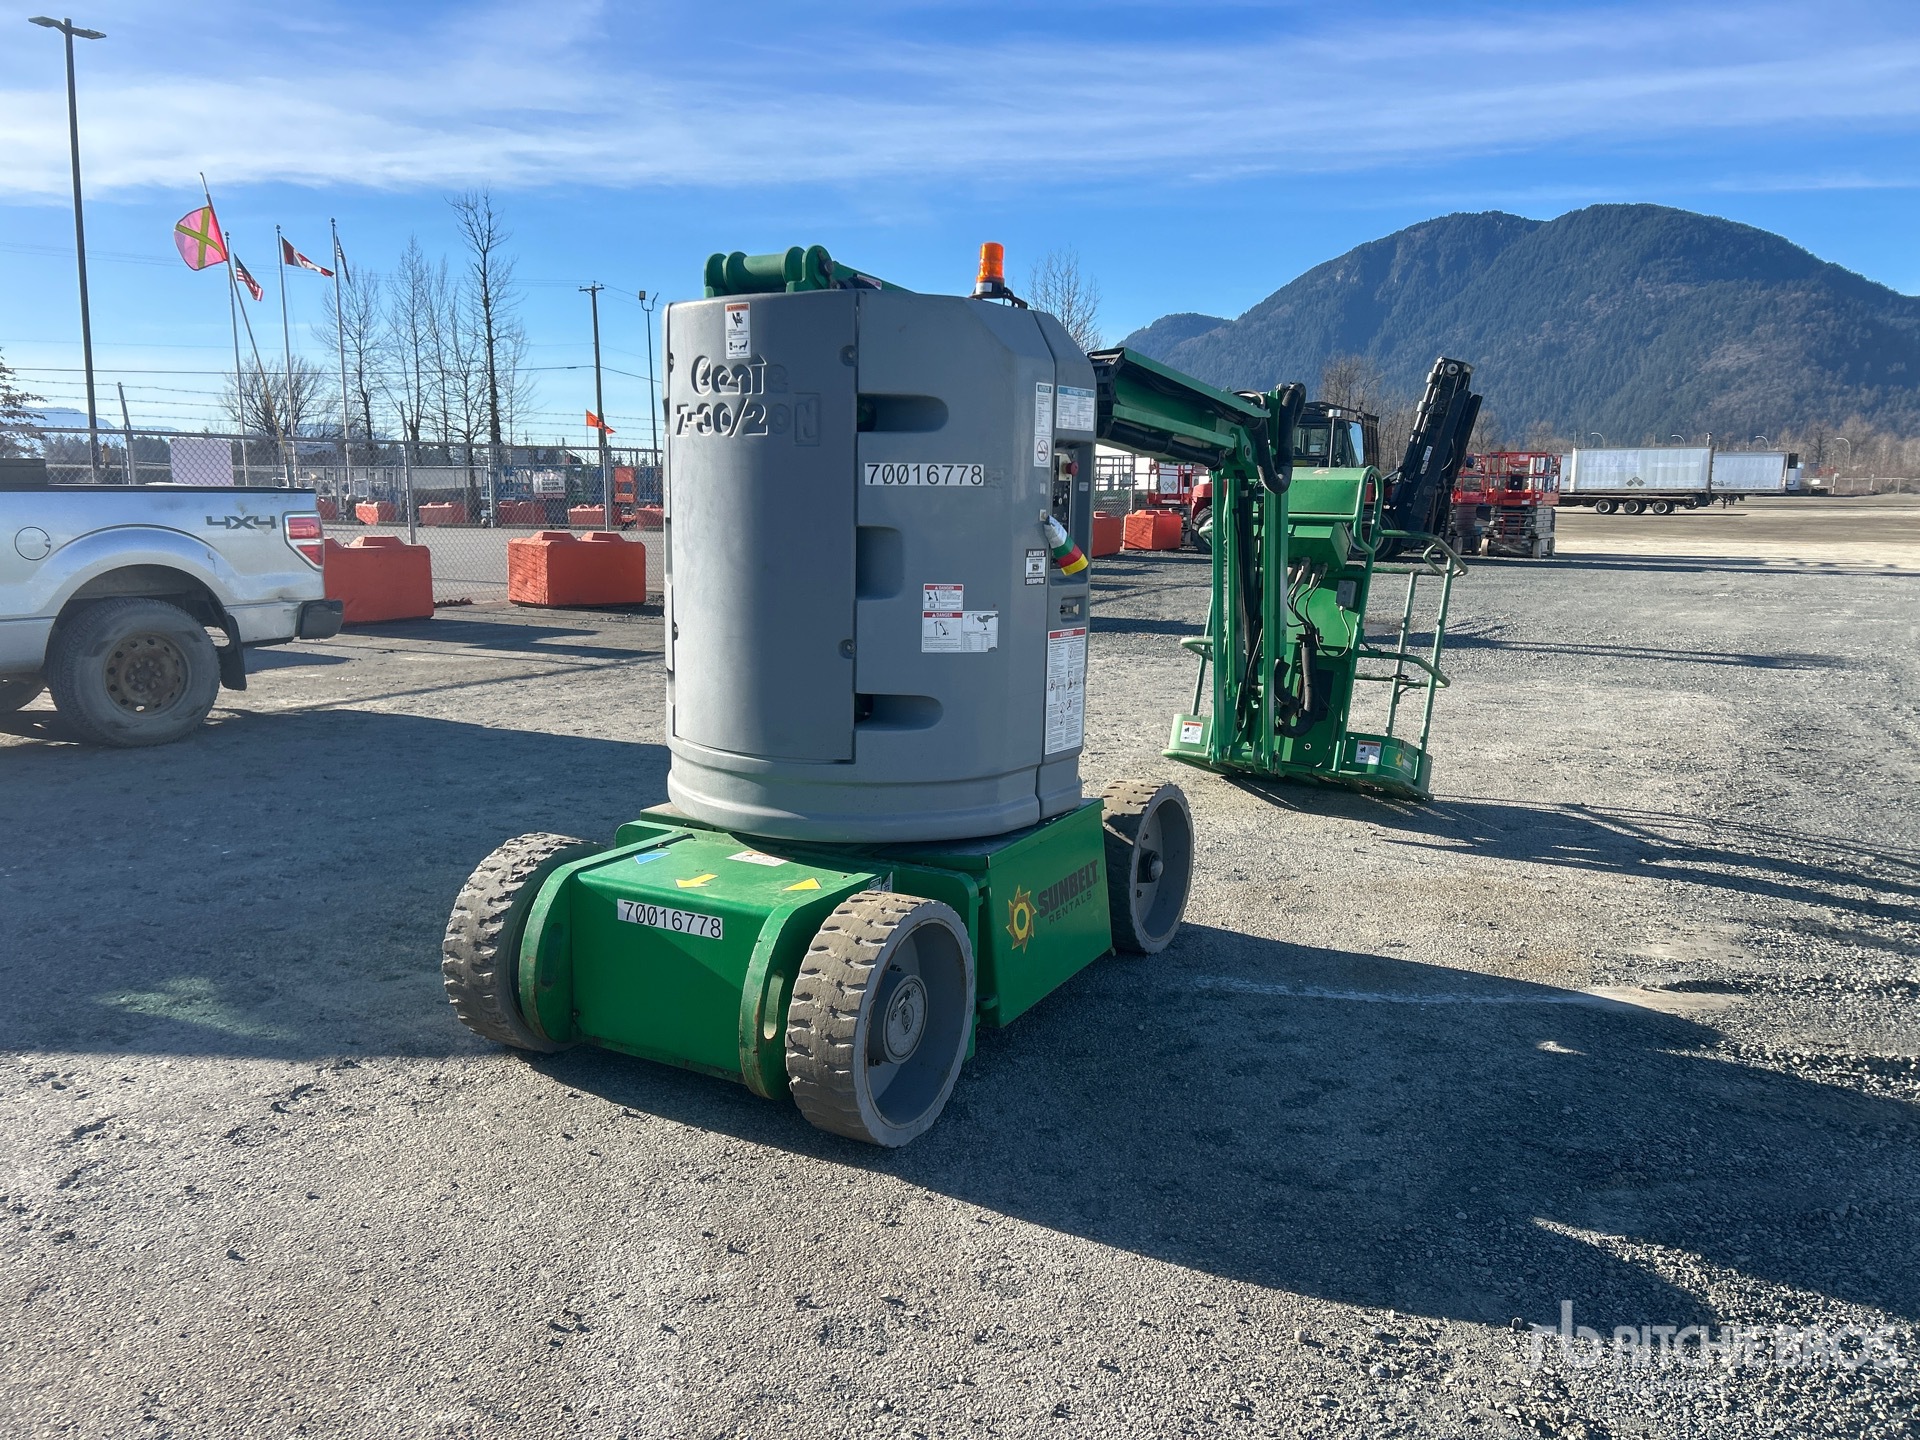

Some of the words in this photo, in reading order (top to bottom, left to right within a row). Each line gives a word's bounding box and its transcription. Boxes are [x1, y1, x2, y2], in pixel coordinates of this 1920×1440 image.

[690, 353, 789, 396] Genie
[866, 464, 983, 486] 70016778
[1037, 859, 1098, 919] SUNBELT
[1048, 890, 1092, 926] RENTALS
[623, 901, 722, 939] 70016778
